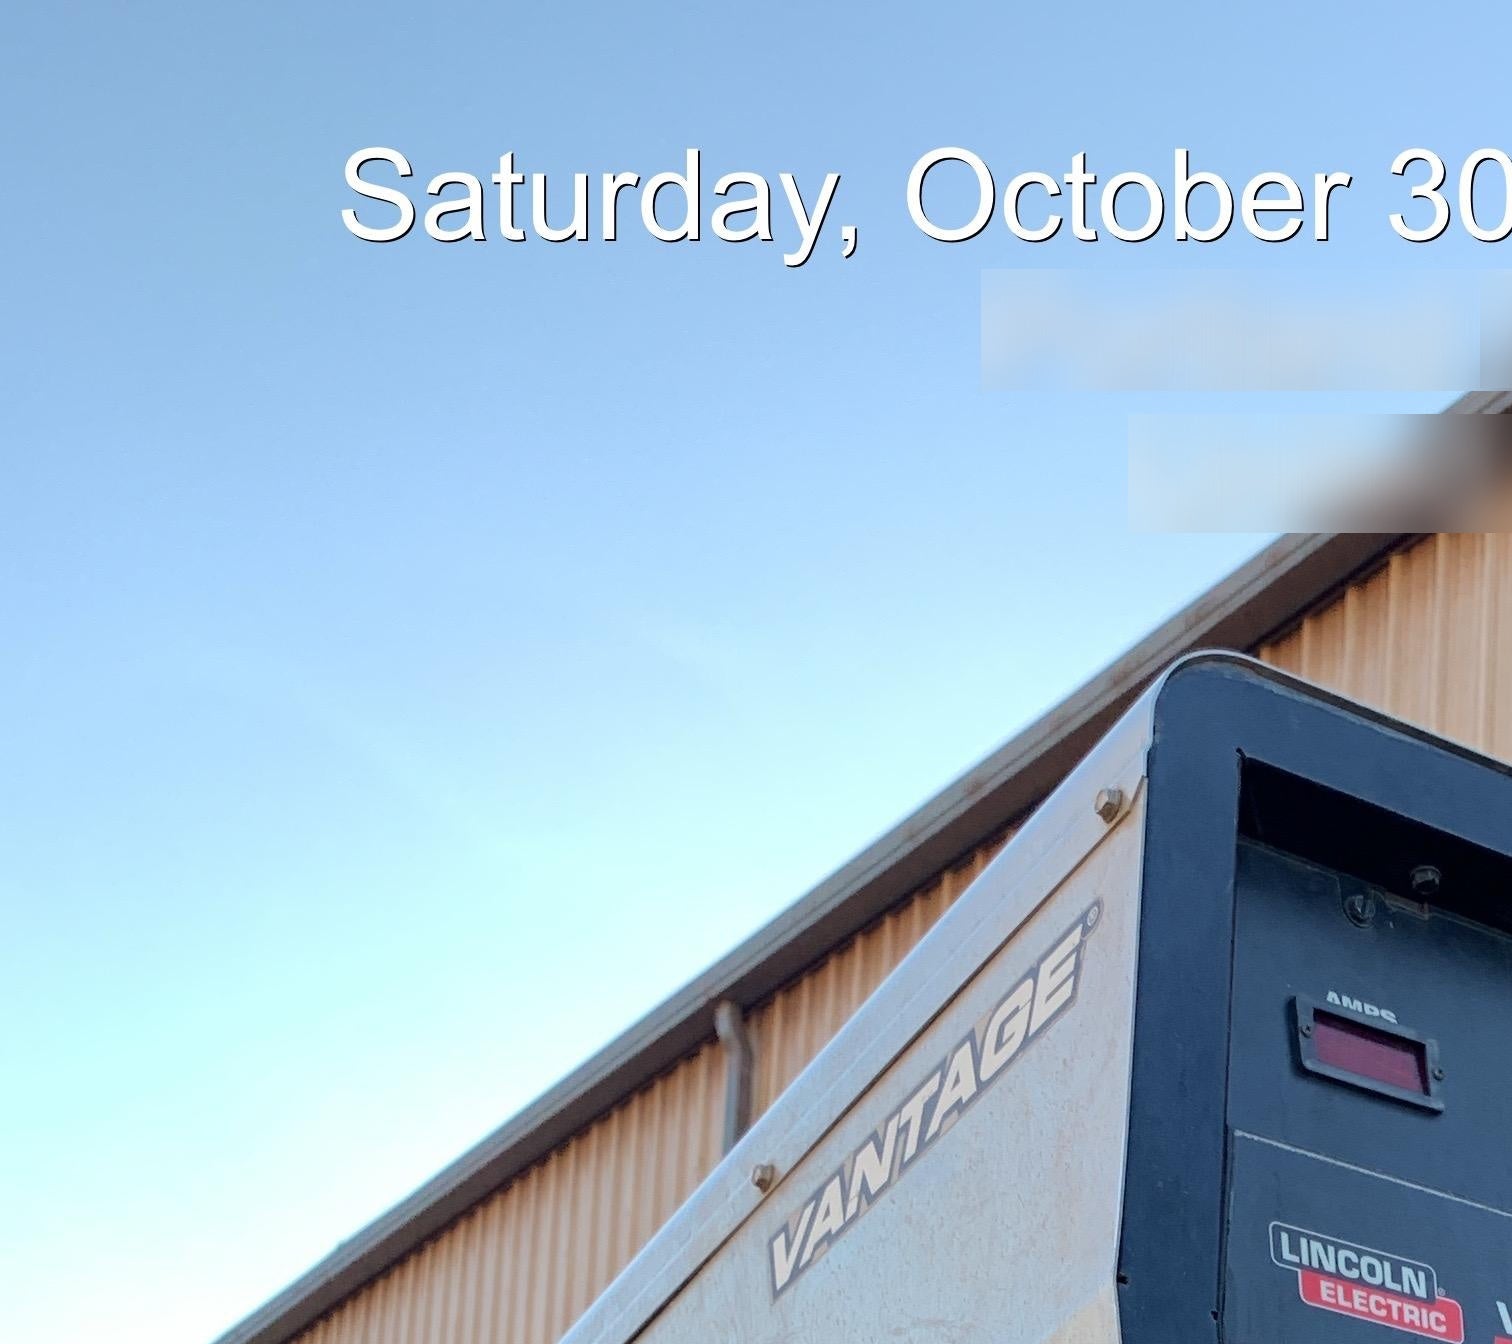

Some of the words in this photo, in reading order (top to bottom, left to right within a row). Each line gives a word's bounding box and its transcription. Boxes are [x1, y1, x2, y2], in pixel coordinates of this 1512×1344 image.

[772, 924, 1085, 1297] VANTAGE
[1280, 1231, 1428, 1299] LINCOLN
[1319, 1279, 1448, 1334] ELECTRIC
